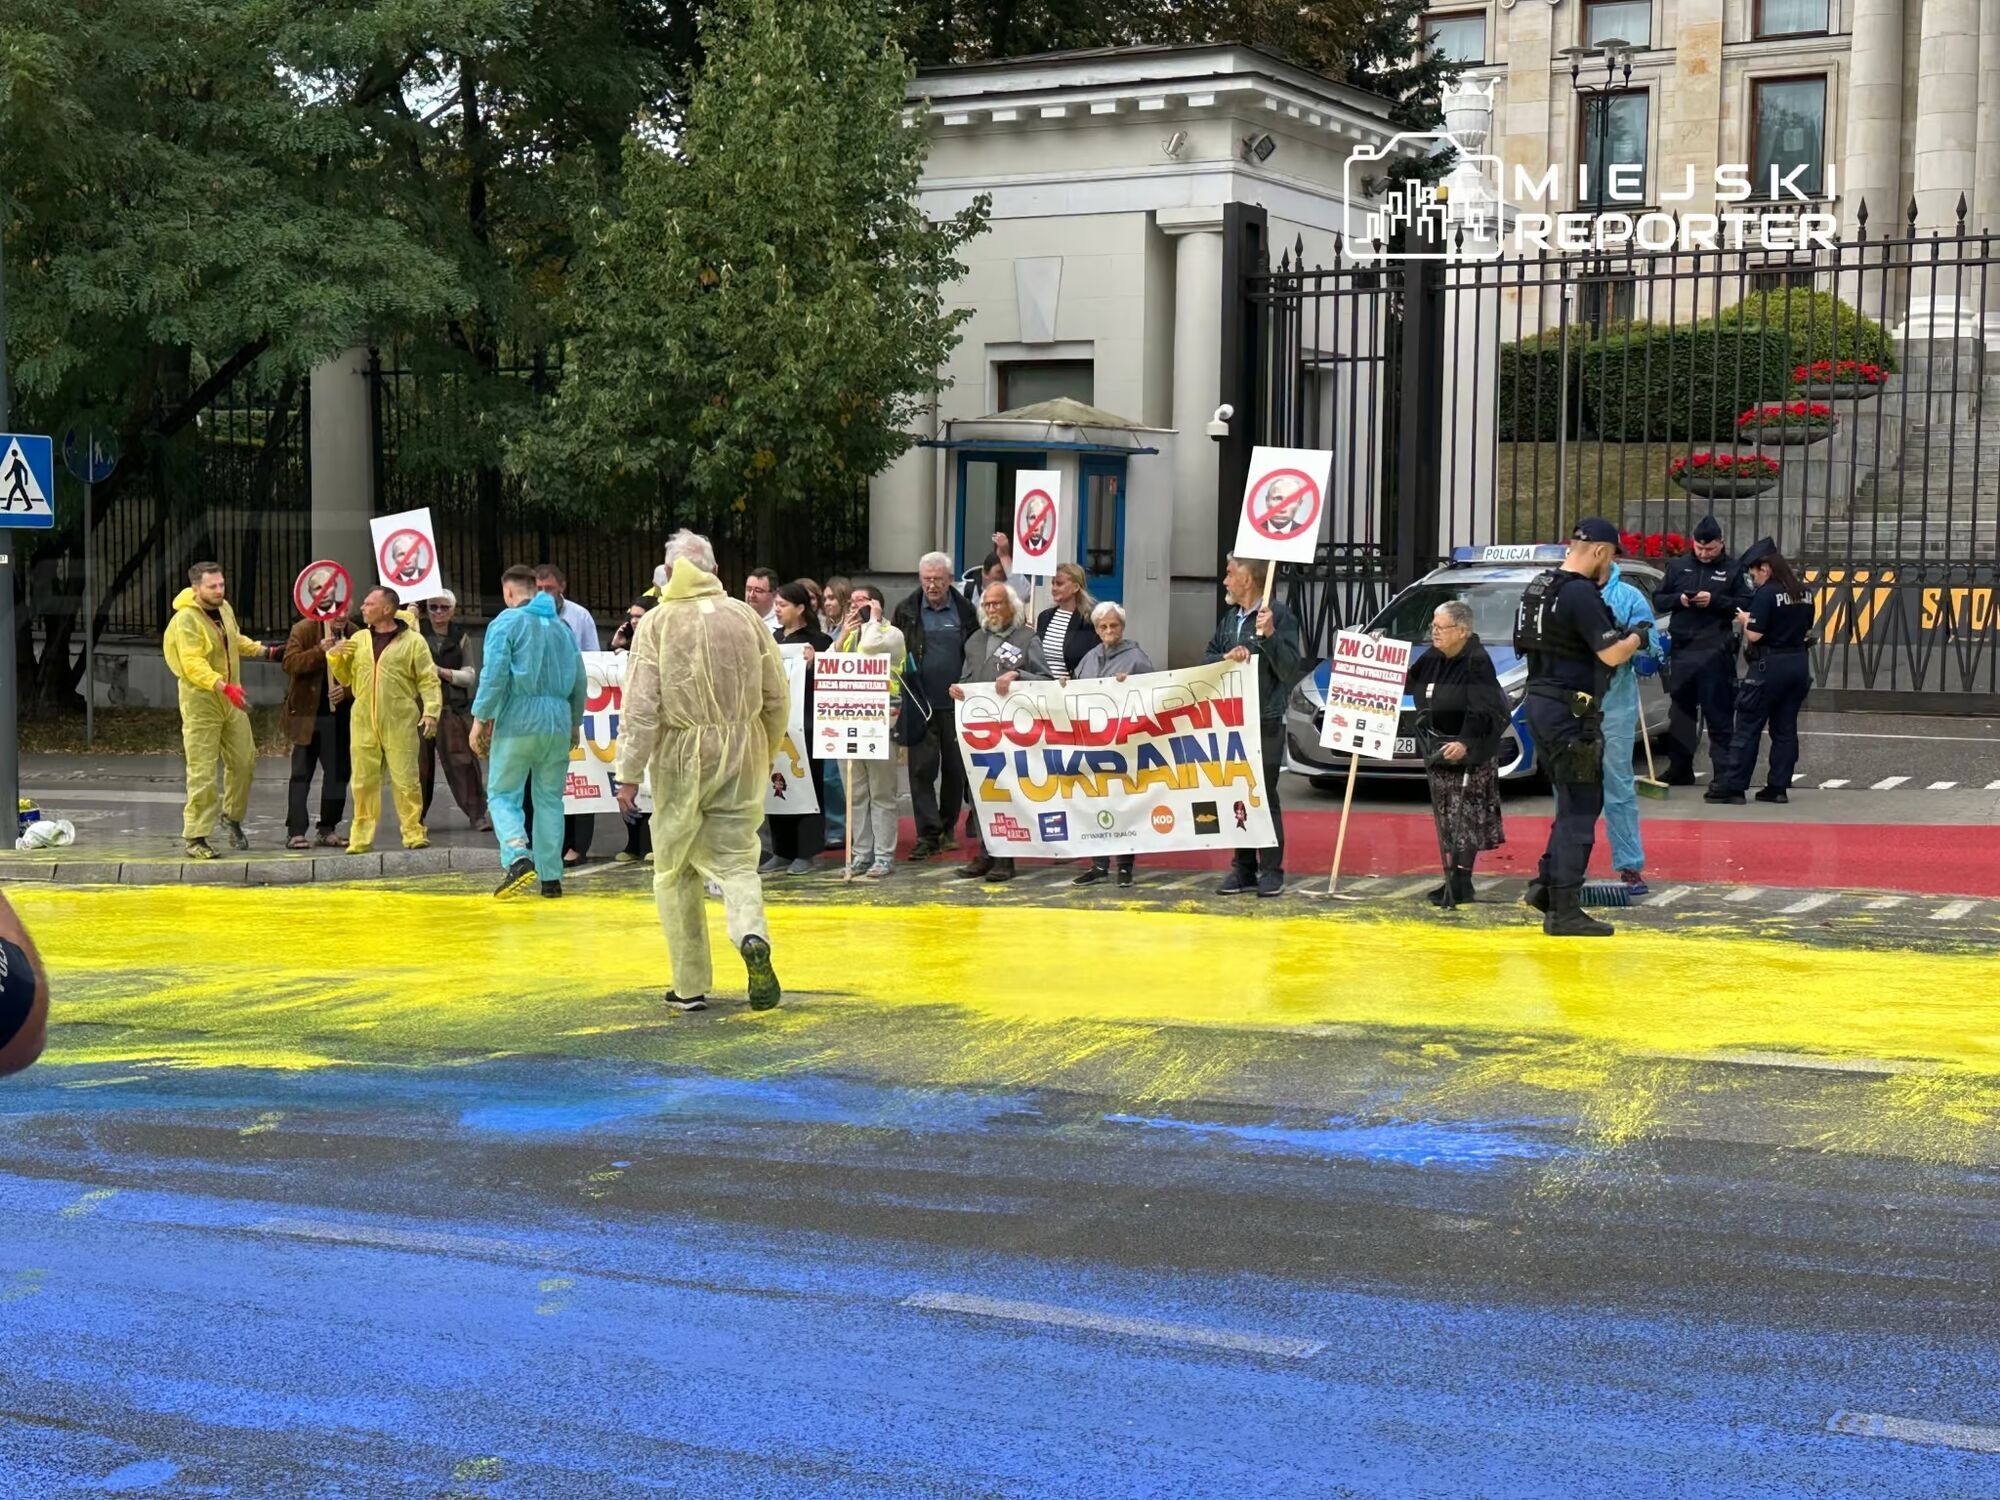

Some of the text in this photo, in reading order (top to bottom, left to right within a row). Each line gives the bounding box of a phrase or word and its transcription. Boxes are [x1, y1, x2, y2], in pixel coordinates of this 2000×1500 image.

[1485, 548, 1530, 560] POLICJA
[1921, 587, 2000, 630] STO
[961, 670, 1245, 750] SOLIDARNI
[969, 751, 1012, 802] Z
[1152, 814, 1174, 825] KOD
